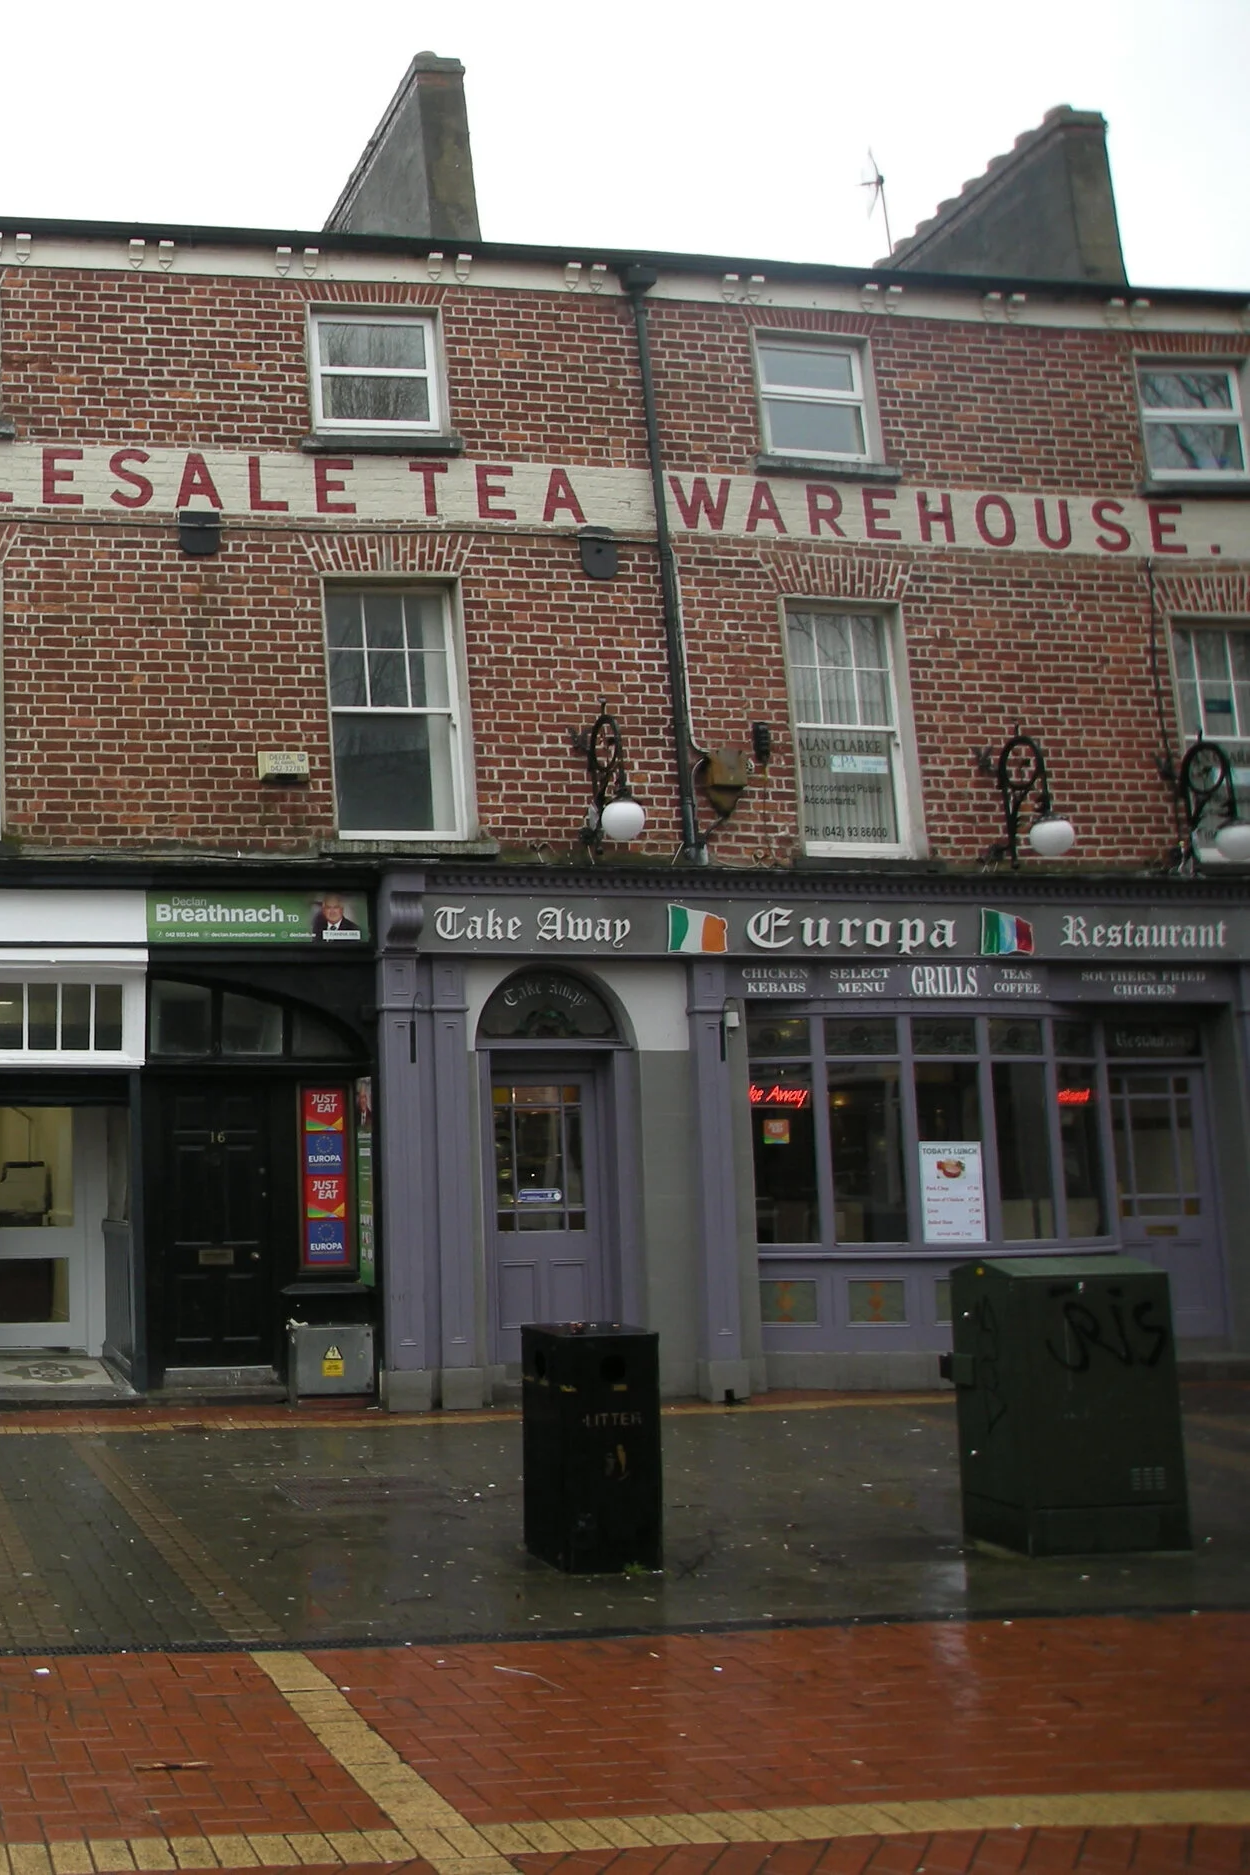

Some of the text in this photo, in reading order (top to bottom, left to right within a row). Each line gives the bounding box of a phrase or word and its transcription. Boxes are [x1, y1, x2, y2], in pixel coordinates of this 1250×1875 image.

[409, 461, 587, 523] TEA
[668, 475, 1222, 556] WAREHOUSE.
[833, 739, 882, 753] CLARKE
[803, 783, 882, 793] Incorporated Public
[803, 796, 857, 806] Accountants
[822, 826, 845, 839] (042)
[172, 897, 207, 907] Declan
[155, 904, 299, 923] Breathnach TD
[434, 905, 631, 949] Take Away
[747, 906, 958, 956] Europa
[1060, 914, 1227, 948] Restaurant
[742, 968, 810, 979] CHICKEN
[829, 968, 891, 979] SELECT
[1001, 968, 1034, 980] TEAS
[1081, 971, 1206, 982] SOUTHERN FRIED
[911, 964, 978, 996] GRILLS
[747, 982, 807, 993] KEBABS
[837, 982, 886, 993] MENU
[993, 982, 1042, 994] COFFEE
[1113, 983, 1177, 996] CHICKEN
[312, 1093, 337, 1104] JUST
[766, 1085, 808, 1108] Away
[317, 1103, 337, 1113] EAT
[210, 1131, 226, 1143] 16
[922, 1147, 977, 1155] TODAY'S LUNCH
[308, 1154, 342, 1163] EUROPA
[313, 1179, 338, 1191] JUST
[318, 1189, 338, 1200] EAT
[310, 1242, 343, 1251] EUROPA
[586, 1411, 642, 1427] LITTER
